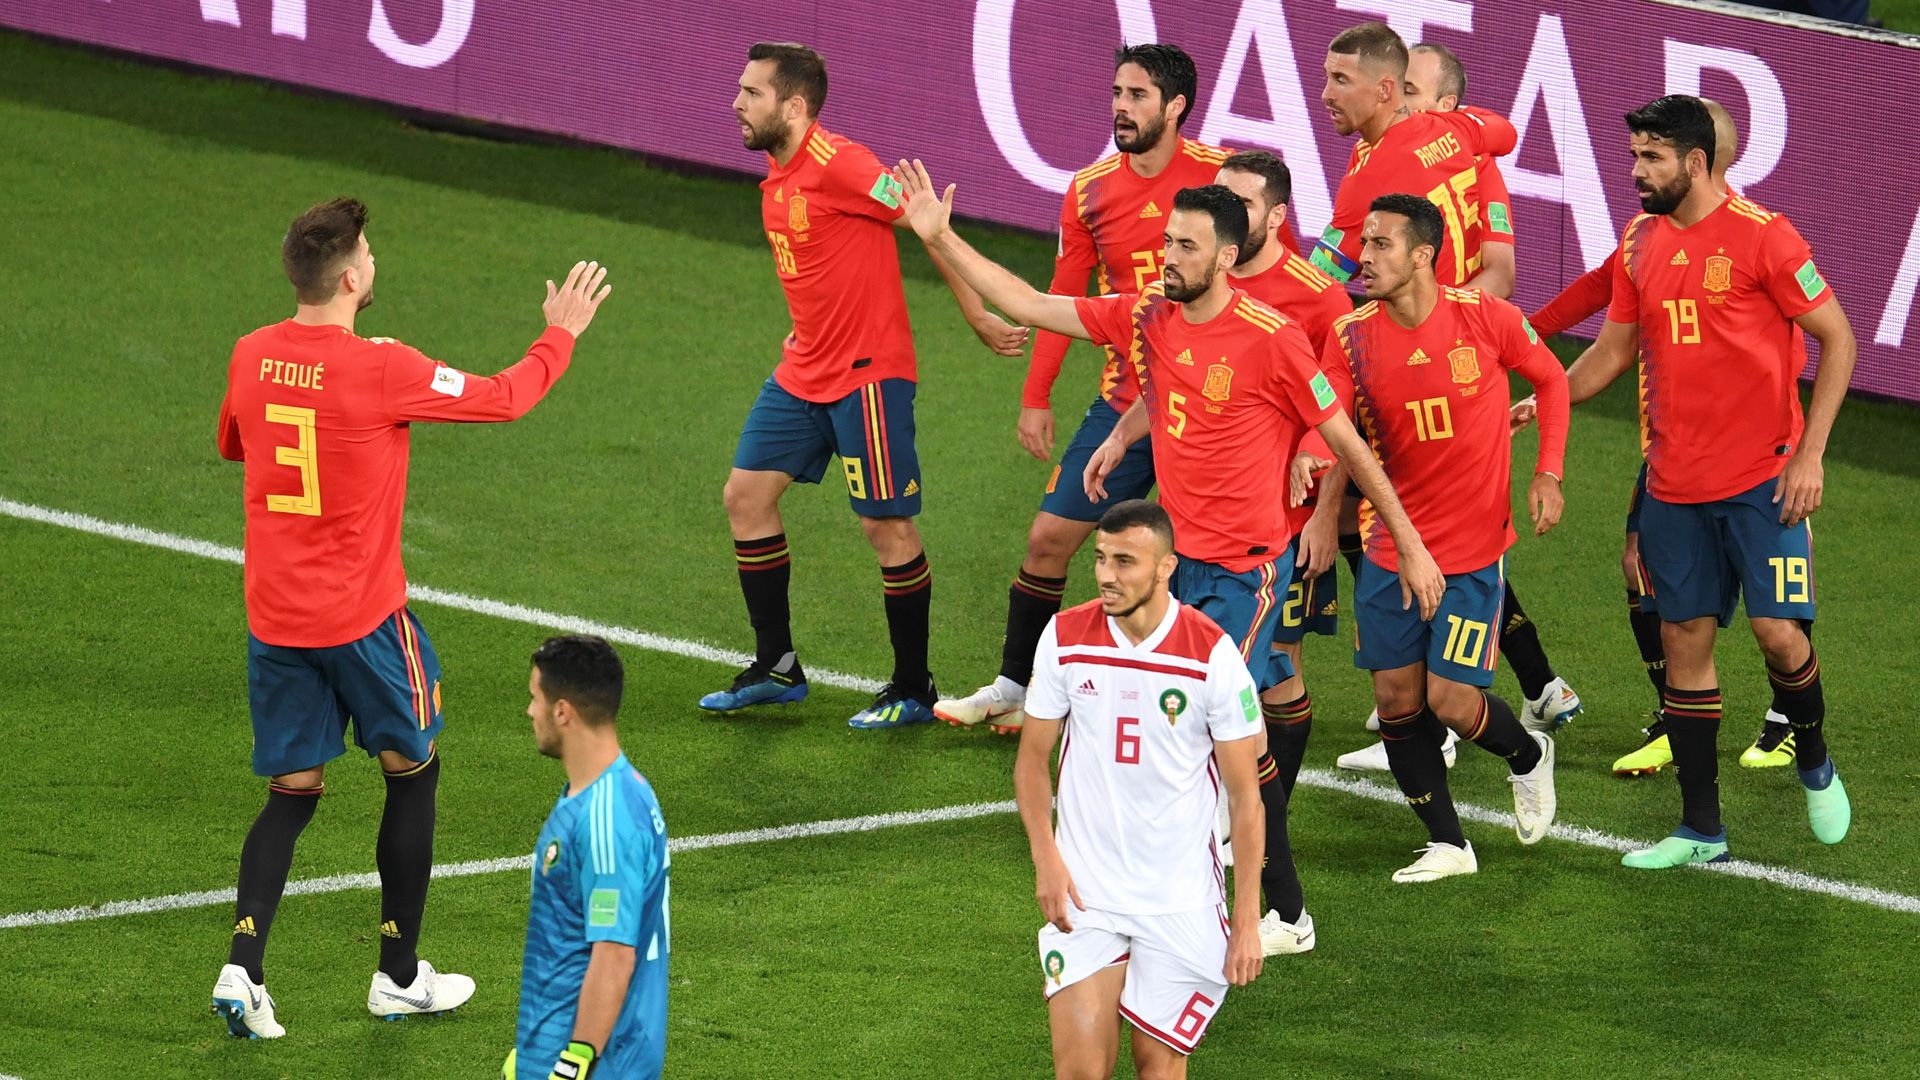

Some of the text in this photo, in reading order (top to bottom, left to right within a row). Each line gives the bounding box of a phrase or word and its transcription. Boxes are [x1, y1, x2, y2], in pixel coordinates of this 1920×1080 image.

[1414, 132, 1462, 168] RAMOS
[1427, 166, 1482, 285] 15
[1662, 299, 1701, 345] 19
[259, 358, 325, 390] PIQUÉ
[1167, 391, 1187, 440] 5
[1405, 396, 1454, 442] 10
[265, 403, 322, 517] 3
[1768, 557, 1809, 603] 19
[1282, 582, 1304, 627] 2
[1442, 614, 1488, 668] 10
[1115, 717, 1140, 764] 6
[1172, 991, 1215, 1041] 6
